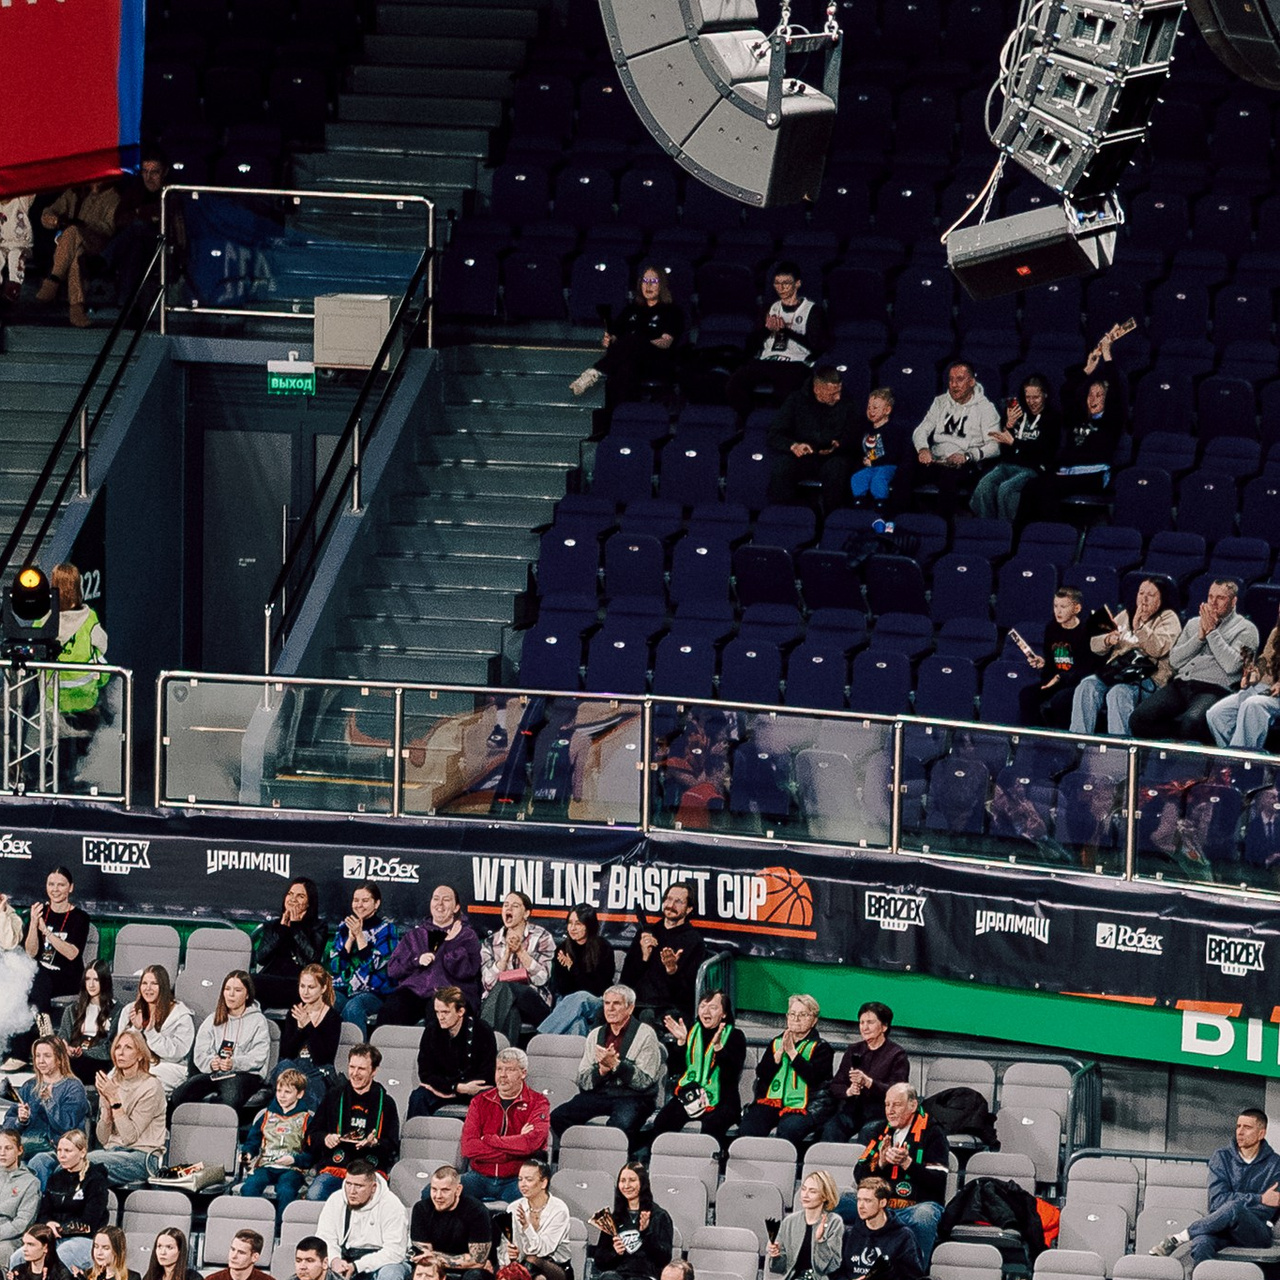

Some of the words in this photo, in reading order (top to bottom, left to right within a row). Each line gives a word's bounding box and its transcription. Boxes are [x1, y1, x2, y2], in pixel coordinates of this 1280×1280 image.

[271, 378, 312, 391] ВЫХОД
[84, 839, 149, 866] BROZEX
[207, 850, 291, 879] УРАЛМАШ
[368, 857, 419, 878] Робек
[473, 857, 601, 908] WINLINE
[718, 873, 767, 921] CUP
[867, 893, 924, 924] BROZEX
[976, 909, 1050, 944] УРАЛМАШ
[1118, 926, 1163, 950] Робек
[1207, 935, 1265, 969] BROZEX
